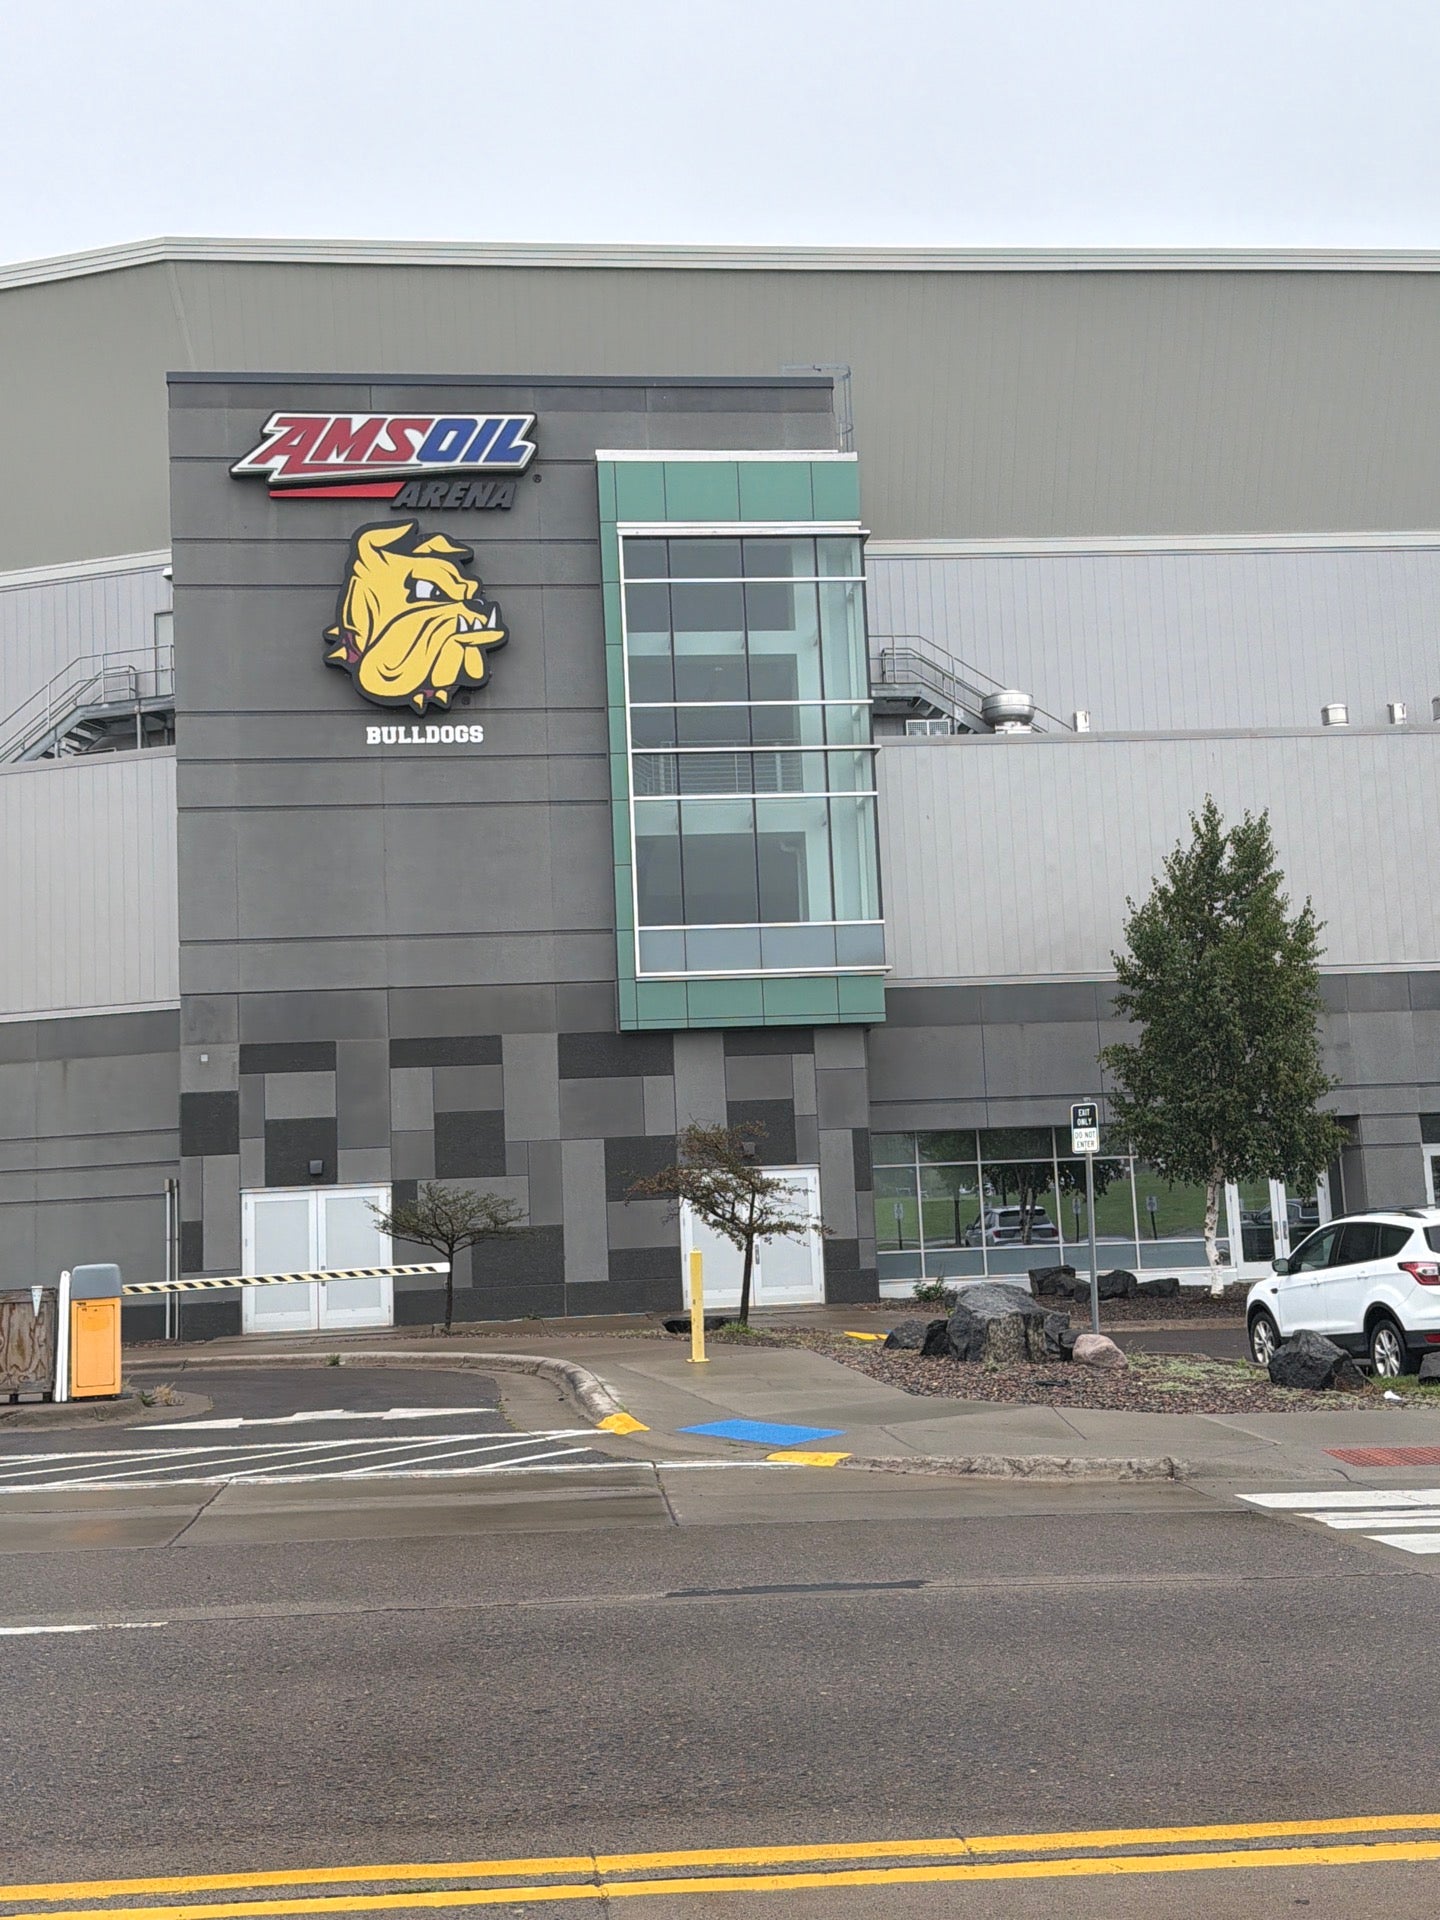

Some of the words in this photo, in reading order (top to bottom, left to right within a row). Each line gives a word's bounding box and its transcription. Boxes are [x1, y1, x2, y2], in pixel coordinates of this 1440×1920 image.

[248, 417, 531, 476] AMSOIL
[391, 481, 517, 509] ARENA
[366, 725, 484, 744] BULLDOGS
[1078, 1109, 1090, 1117] EXIT
[1077, 1118, 1092, 1126] ONLY
[1075, 1131, 1083, 1139] DO
[1084, 1130, 1096, 1138] NOT
[1076, 1140, 1095, 1148] ENTER
